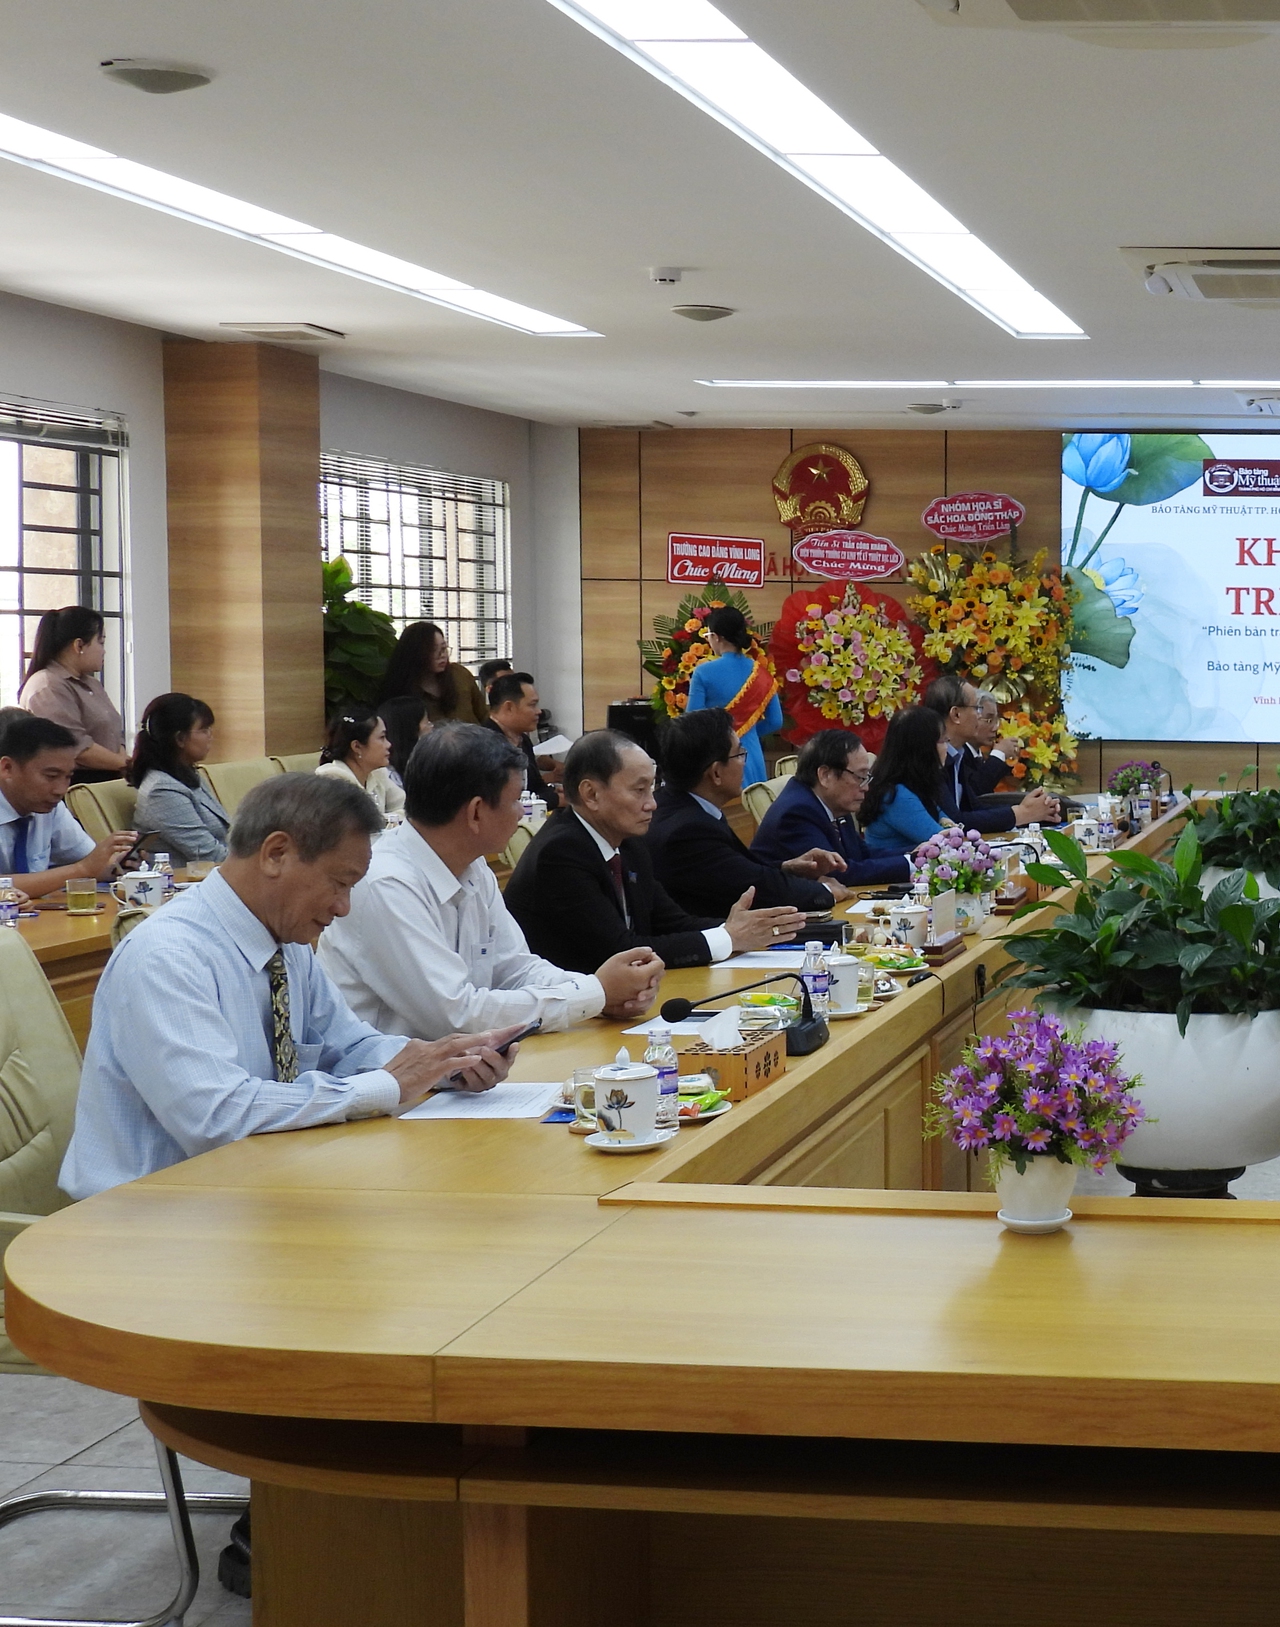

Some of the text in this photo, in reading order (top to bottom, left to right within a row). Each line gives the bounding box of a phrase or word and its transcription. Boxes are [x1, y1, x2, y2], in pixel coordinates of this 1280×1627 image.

[1238, 475, 1257, 488] Mỹ
[941, 500, 971, 513] NHÓM
[971, 501, 992, 513] HỌA
[1151, 504, 1172, 514] BẢO
[1173, 505, 1201, 514] TÀNG
[1202, 505, 1218, 515] MỸ
[1219, 505, 1254, 516] THUẬT
[1255, 506, 1269, 515] TP.
[927, 512, 946, 525] SẮC
[946, 514, 967, 523] HOA
[994, 509, 1020, 520] THÁP
[673, 540, 760, 561] TRƯỜNG CAO ĐẲNG VĨNH LONG
[673, 559, 759, 583] Chúc Mừng
[811, 559, 845, 569] Chúc
[849, 561, 886, 572] Mừng
[1201, 625, 1242, 637] “Phiên
[1244, 625, 1267, 637] bản
[1207, 660, 1230, 672] Bảo
[1233, 661, 1259, 675] tàng
[1262, 661, 1280, 675] Mỹ
[1253, 696, 1277, 705] Vĩnh
